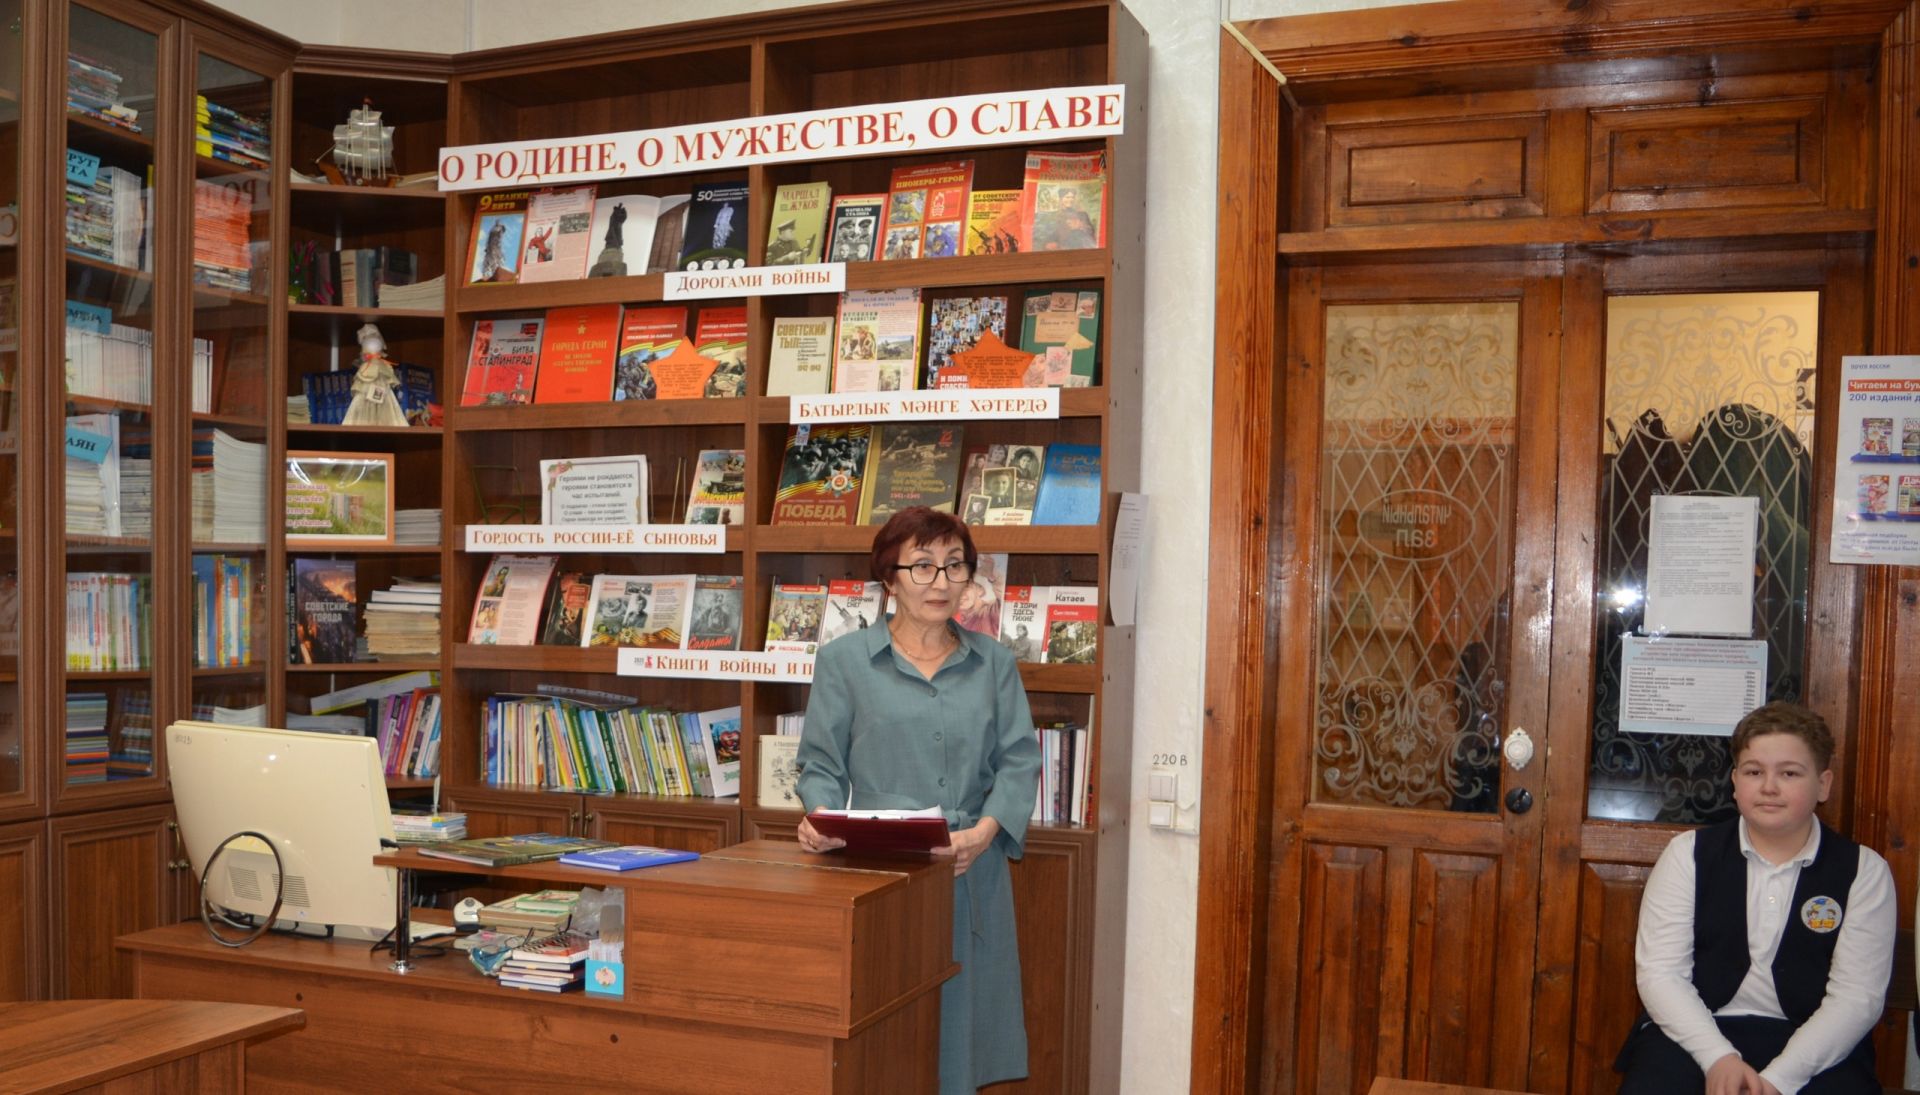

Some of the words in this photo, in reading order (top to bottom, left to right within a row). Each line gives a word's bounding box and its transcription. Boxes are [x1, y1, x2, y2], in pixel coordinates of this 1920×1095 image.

[440, 155, 464, 183] О
[475, 142, 627, 182] РОДИНЕ,
[637, 137, 664, 167] О
[673, 111, 916, 164] МУЖЕСТВЕ,
[928, 106, 958, 139] О
[971, 94, 1122, 135] СЛАВЕ
[697, 190, 713, 201] 50
[782, 189, 820, 200] МАРШАЛ
[480, 195, 492, 211] 9
[493, 193, 529, 202] ВЕЛИКИ
[790, 200, 818, 211] ЖУКОВ
[677, 274, 763, 292] ДОРОГАМИ
[772, 269, 831, 285] ВОЙНЫ
[777, 322, 827, 336] СОВЕТСКИЙ
[780, 337, 799, 349] ТЫЛ
[478, 354, 533, 366] СТАЛИНГРАД
[1850, 381, 1888, 390] Читаем
[1889, 382, 1902, 390] на
[1850, 393, 1868, 402] 200
[1869, 393, 1912, 404] изданий
[800, 402, 891, 418] БАТЫРЛЫК
[900, 399, 960, 415] МӘҢГЕ
[969, 398, 1048, 413] ХӘТЕРДӘ
[779, 504, 847, 520] ПОБЕДА
[473, 530, 545, 546] ГОРДОСТЬ
[553, 529, 634, 545] РОССИИ-ЕЁ
[643, 532, 718, 546] СЫНОВЬЯ
[1055, 594, 1085, 602] Катаев
[305, 602, 349, 611] СОВЕТСКИЕ
[312, 612, 343, 622] ГОРОДА
[688, 634, 733, 650] Солдаты
[657, 655, 709, 672] КНИГИ
[719, 658, 776, 675] ВОЙНЫ
[786, 663, 797, 675] И
[1153, 754, 1177, 765] 220
